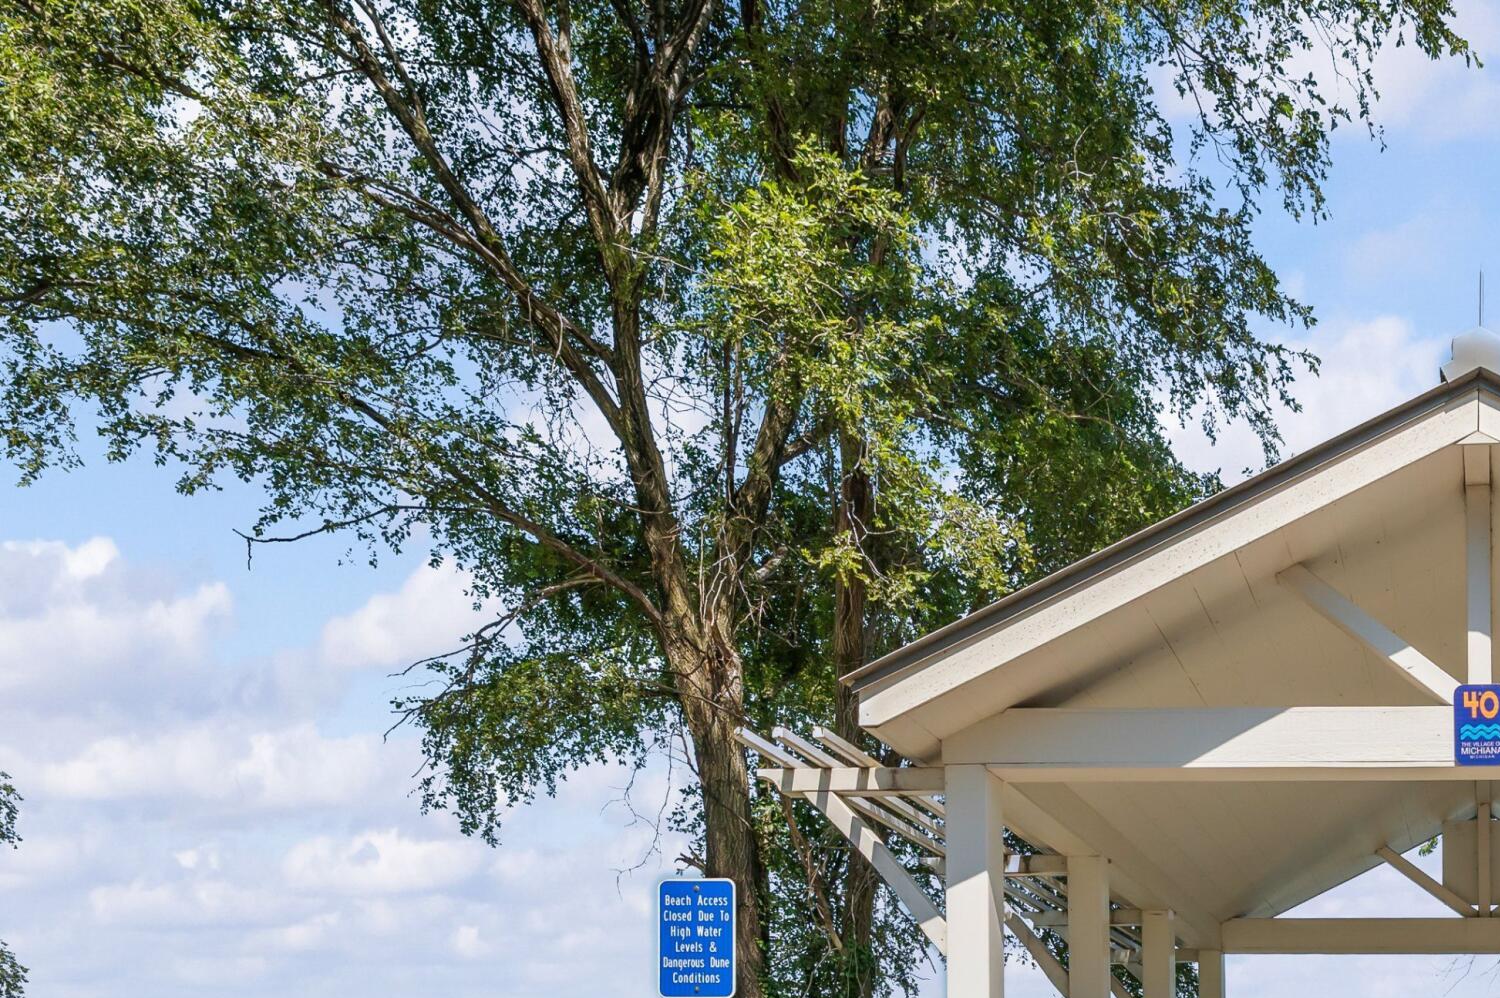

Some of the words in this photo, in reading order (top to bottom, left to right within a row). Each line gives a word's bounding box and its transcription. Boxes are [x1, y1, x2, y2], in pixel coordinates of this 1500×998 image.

[1464, 691, 1499, 718] 40
[664, 894, 692, 906] Beach
[697, 894, 728, 906] Access
[663, 910, 692, 922] Closed
[698, 910, 714, 922] Due
[720, 910, 730, 922] To
[670, 925, 691, 940] High
[697, 925, 722, 937] Water
[675, 941, 703, 953] Levels
[709, 941, 717, 953] &
[663, 956, 705, 971] Dangerous
[710, 956, 730, 968] Dune
[672, 972, 721, 984] Conditions
